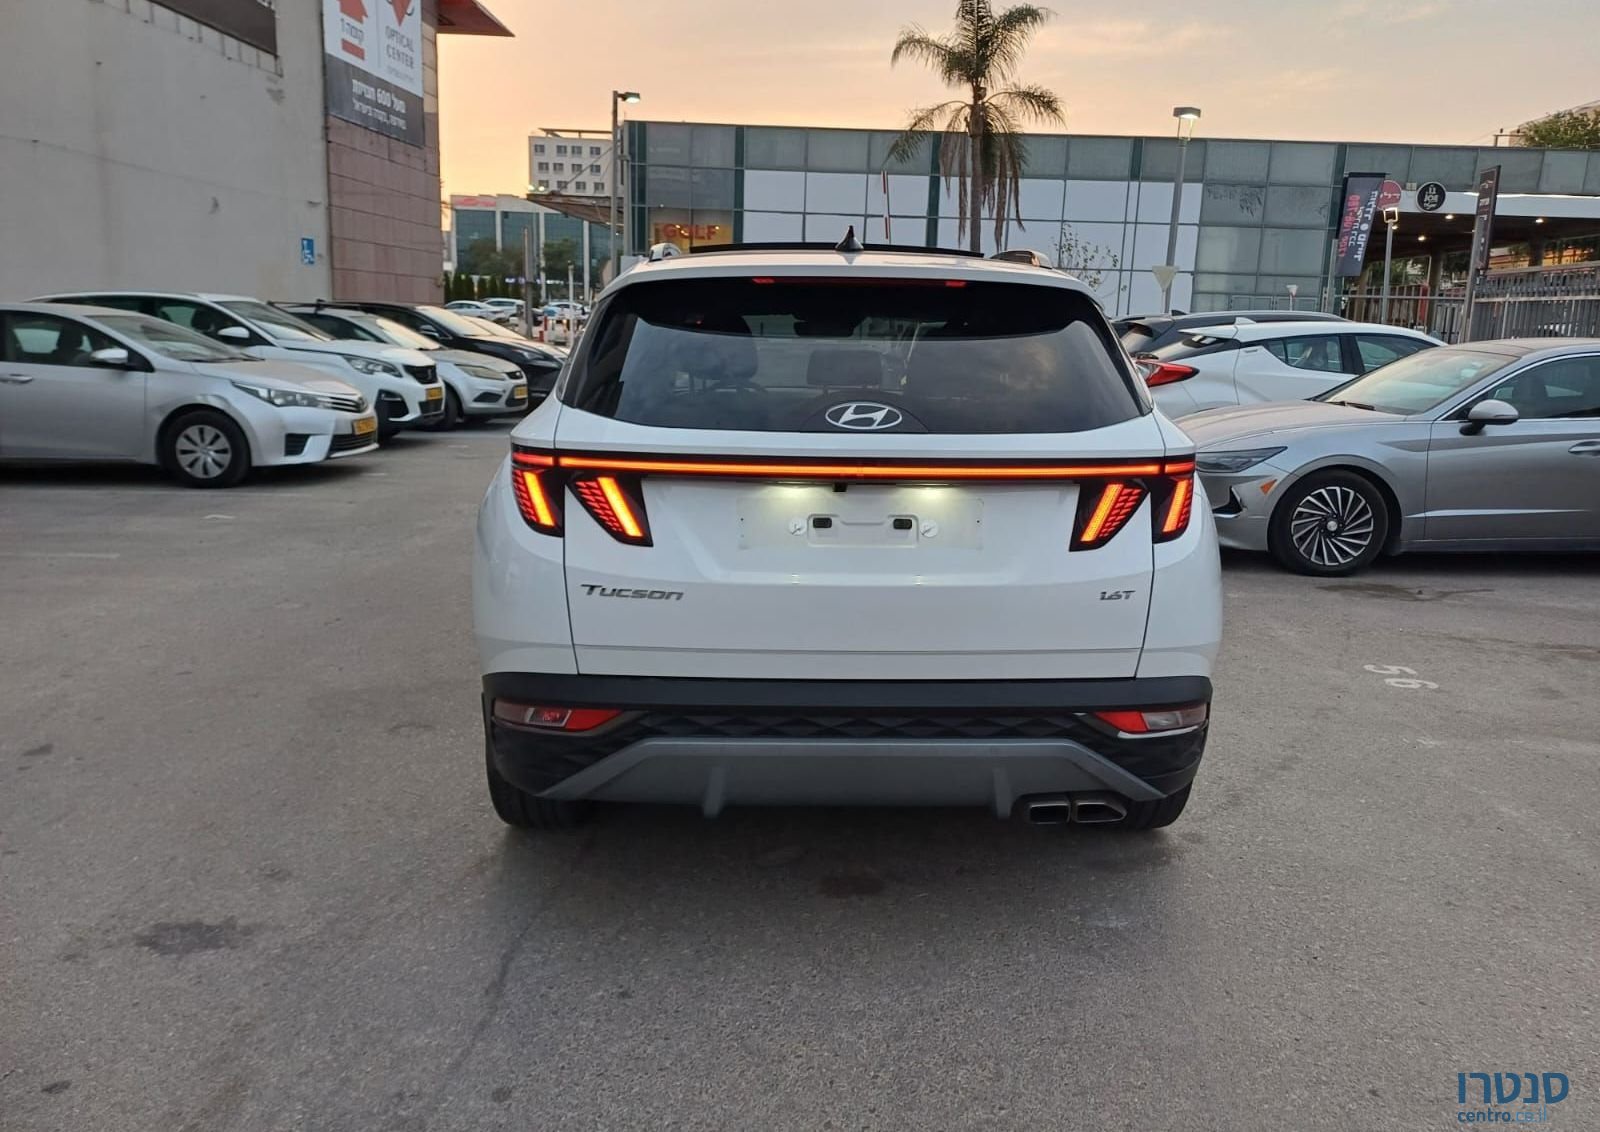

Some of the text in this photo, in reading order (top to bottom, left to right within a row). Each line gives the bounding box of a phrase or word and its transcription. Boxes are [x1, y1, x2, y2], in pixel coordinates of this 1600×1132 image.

[385, 25, 414, 53] OPTICAL
[386, 44, 414, 69] CENTER
[662, 224, 717, 241] GOLF
